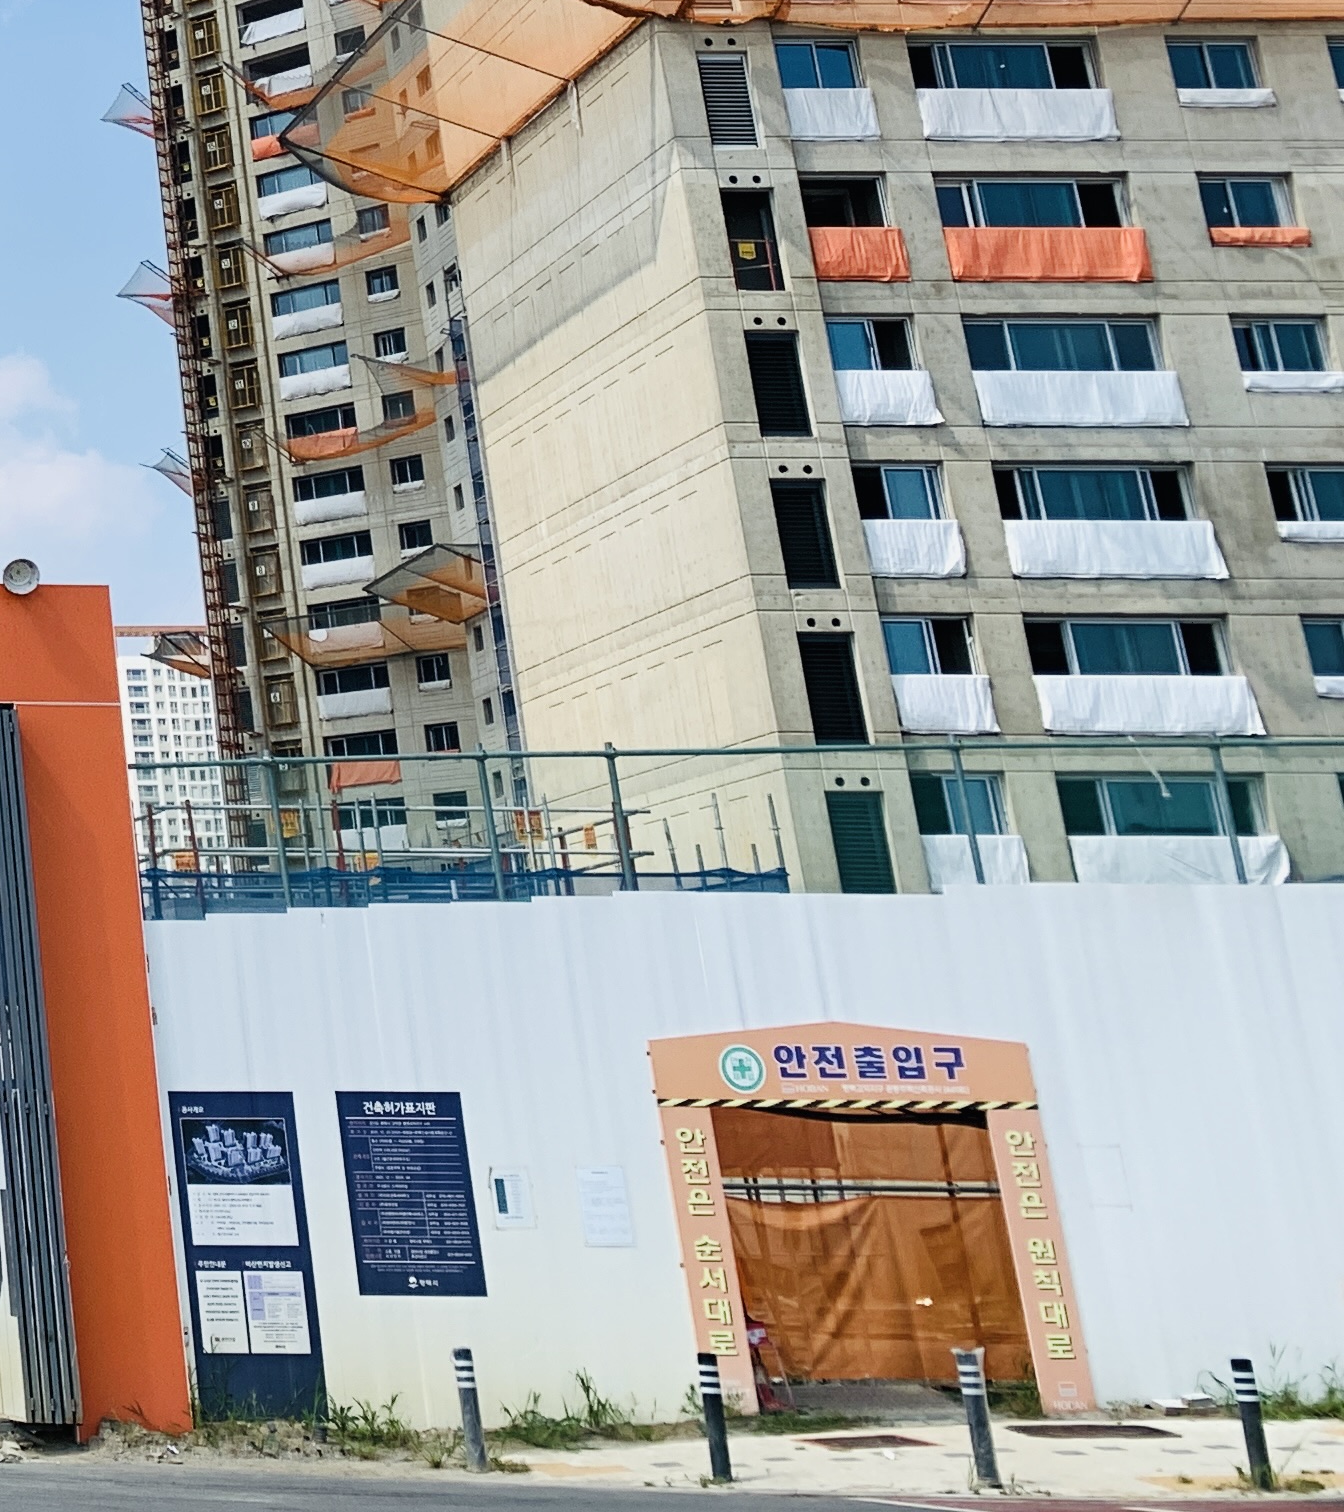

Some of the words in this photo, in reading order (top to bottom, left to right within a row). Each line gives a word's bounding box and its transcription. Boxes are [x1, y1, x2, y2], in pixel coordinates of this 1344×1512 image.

[773, 1044, 966, 1081] 안전출입구
[362, 1100, 436, 1116] 건축허가표지판
[675, 1127, 716, 1217] 안전은
[1004, 1128, 1049, 1220] 안전은
[1027, 1237, 1077, 1361] 원칙대로
[694, 1234, 740, 1356] 순서대로
